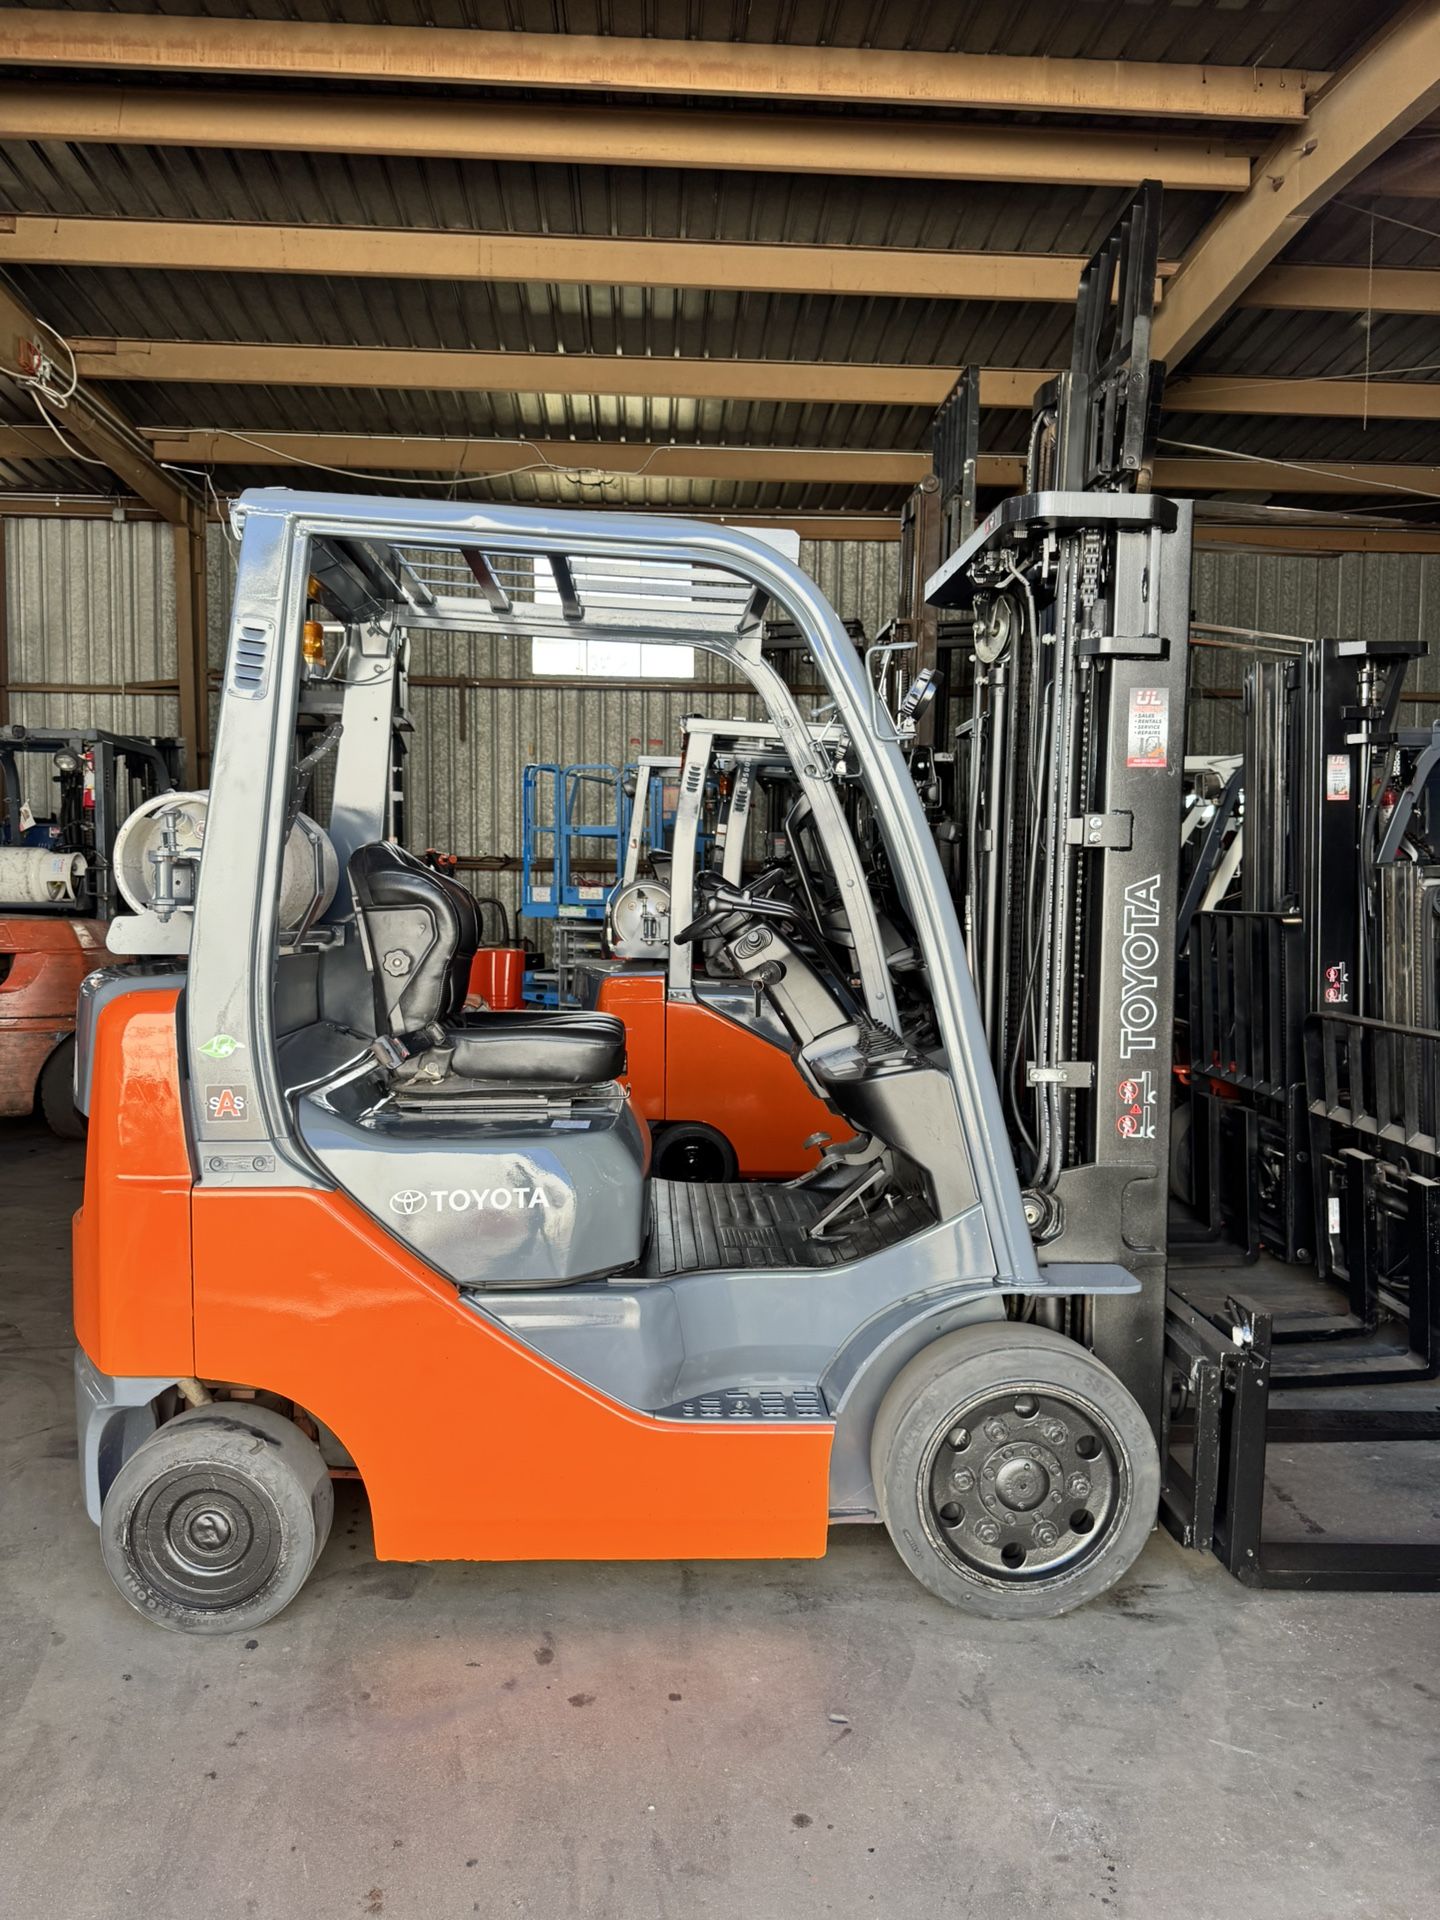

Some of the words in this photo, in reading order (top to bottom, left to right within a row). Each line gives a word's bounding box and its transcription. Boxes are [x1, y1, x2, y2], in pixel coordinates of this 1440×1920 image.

[1120, 873, 1161, 1060] TOYOTA
[209, 1089, 245, 1117] SAS
[431, 1187, 550, 1212] TOYOTA
